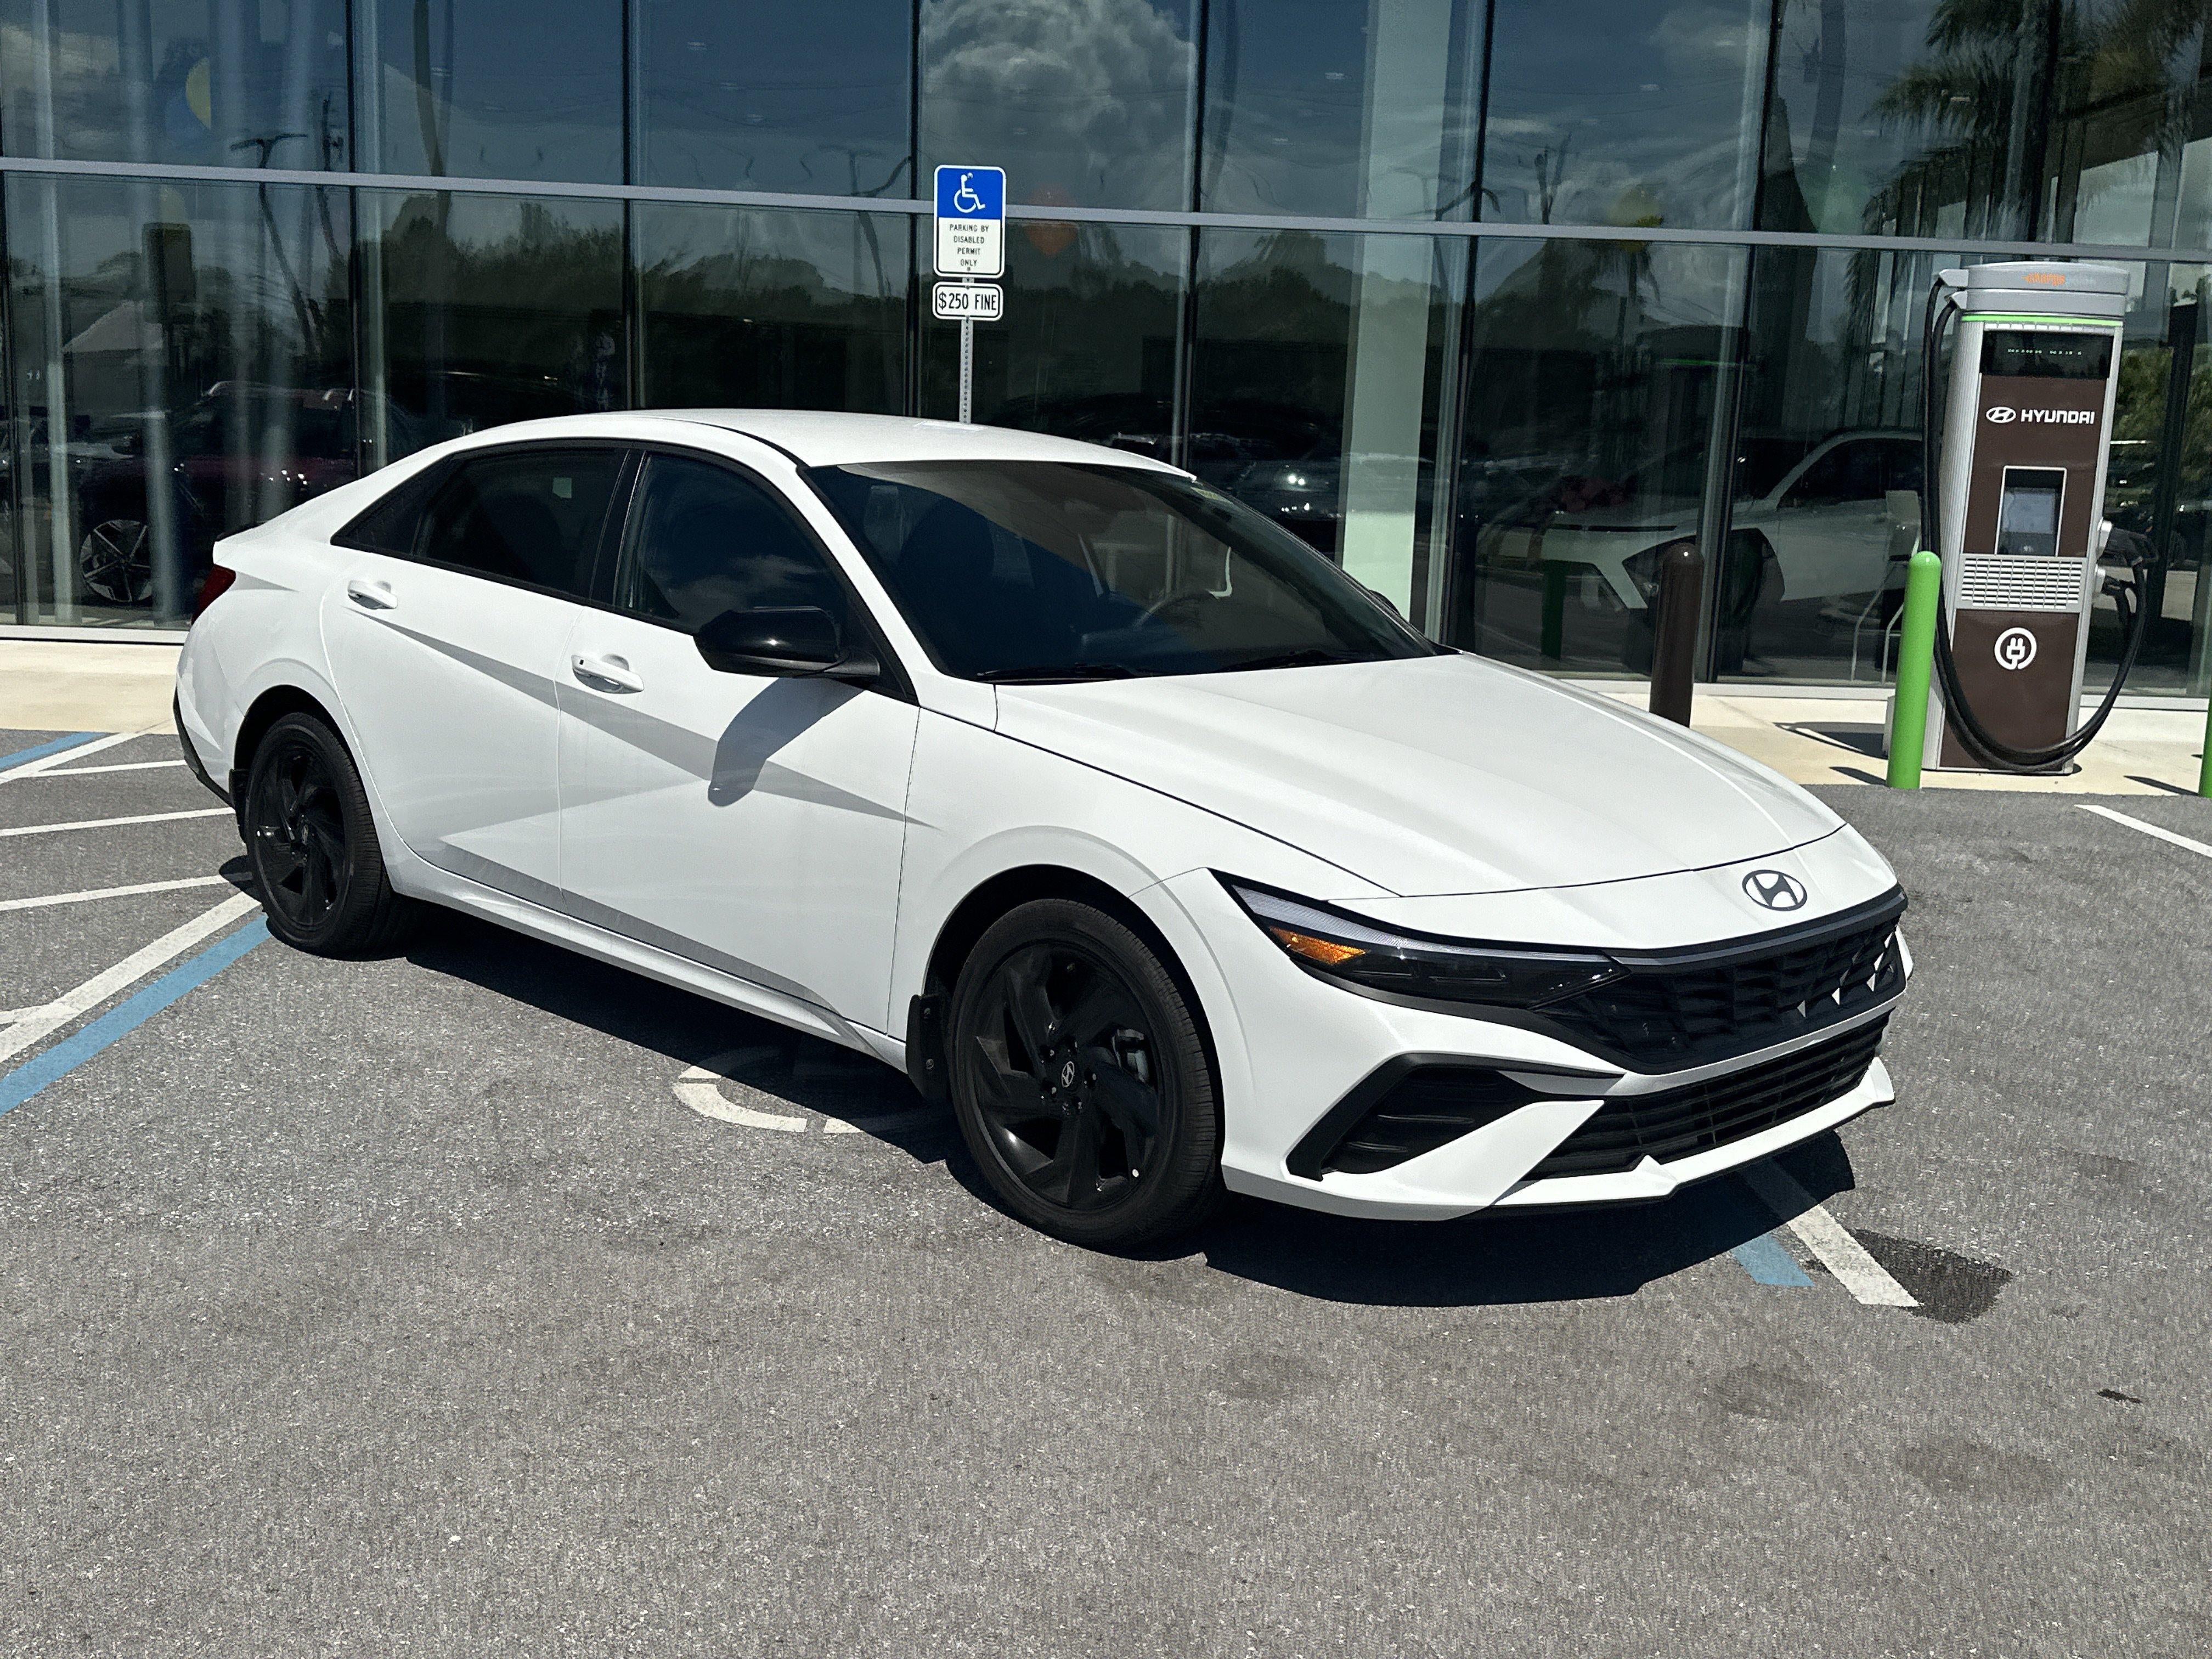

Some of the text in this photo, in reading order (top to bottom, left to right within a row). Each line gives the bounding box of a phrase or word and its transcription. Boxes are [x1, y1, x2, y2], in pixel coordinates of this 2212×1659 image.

[949, 224, 978, 232] PARKING
[953, 235, 985, 244] DISABLED
[957, 247, 981, 255] PERMIT
[938, 291, 997, 311] $250 FINE
[2020, 409, 2095, 425] HYUNDAI
